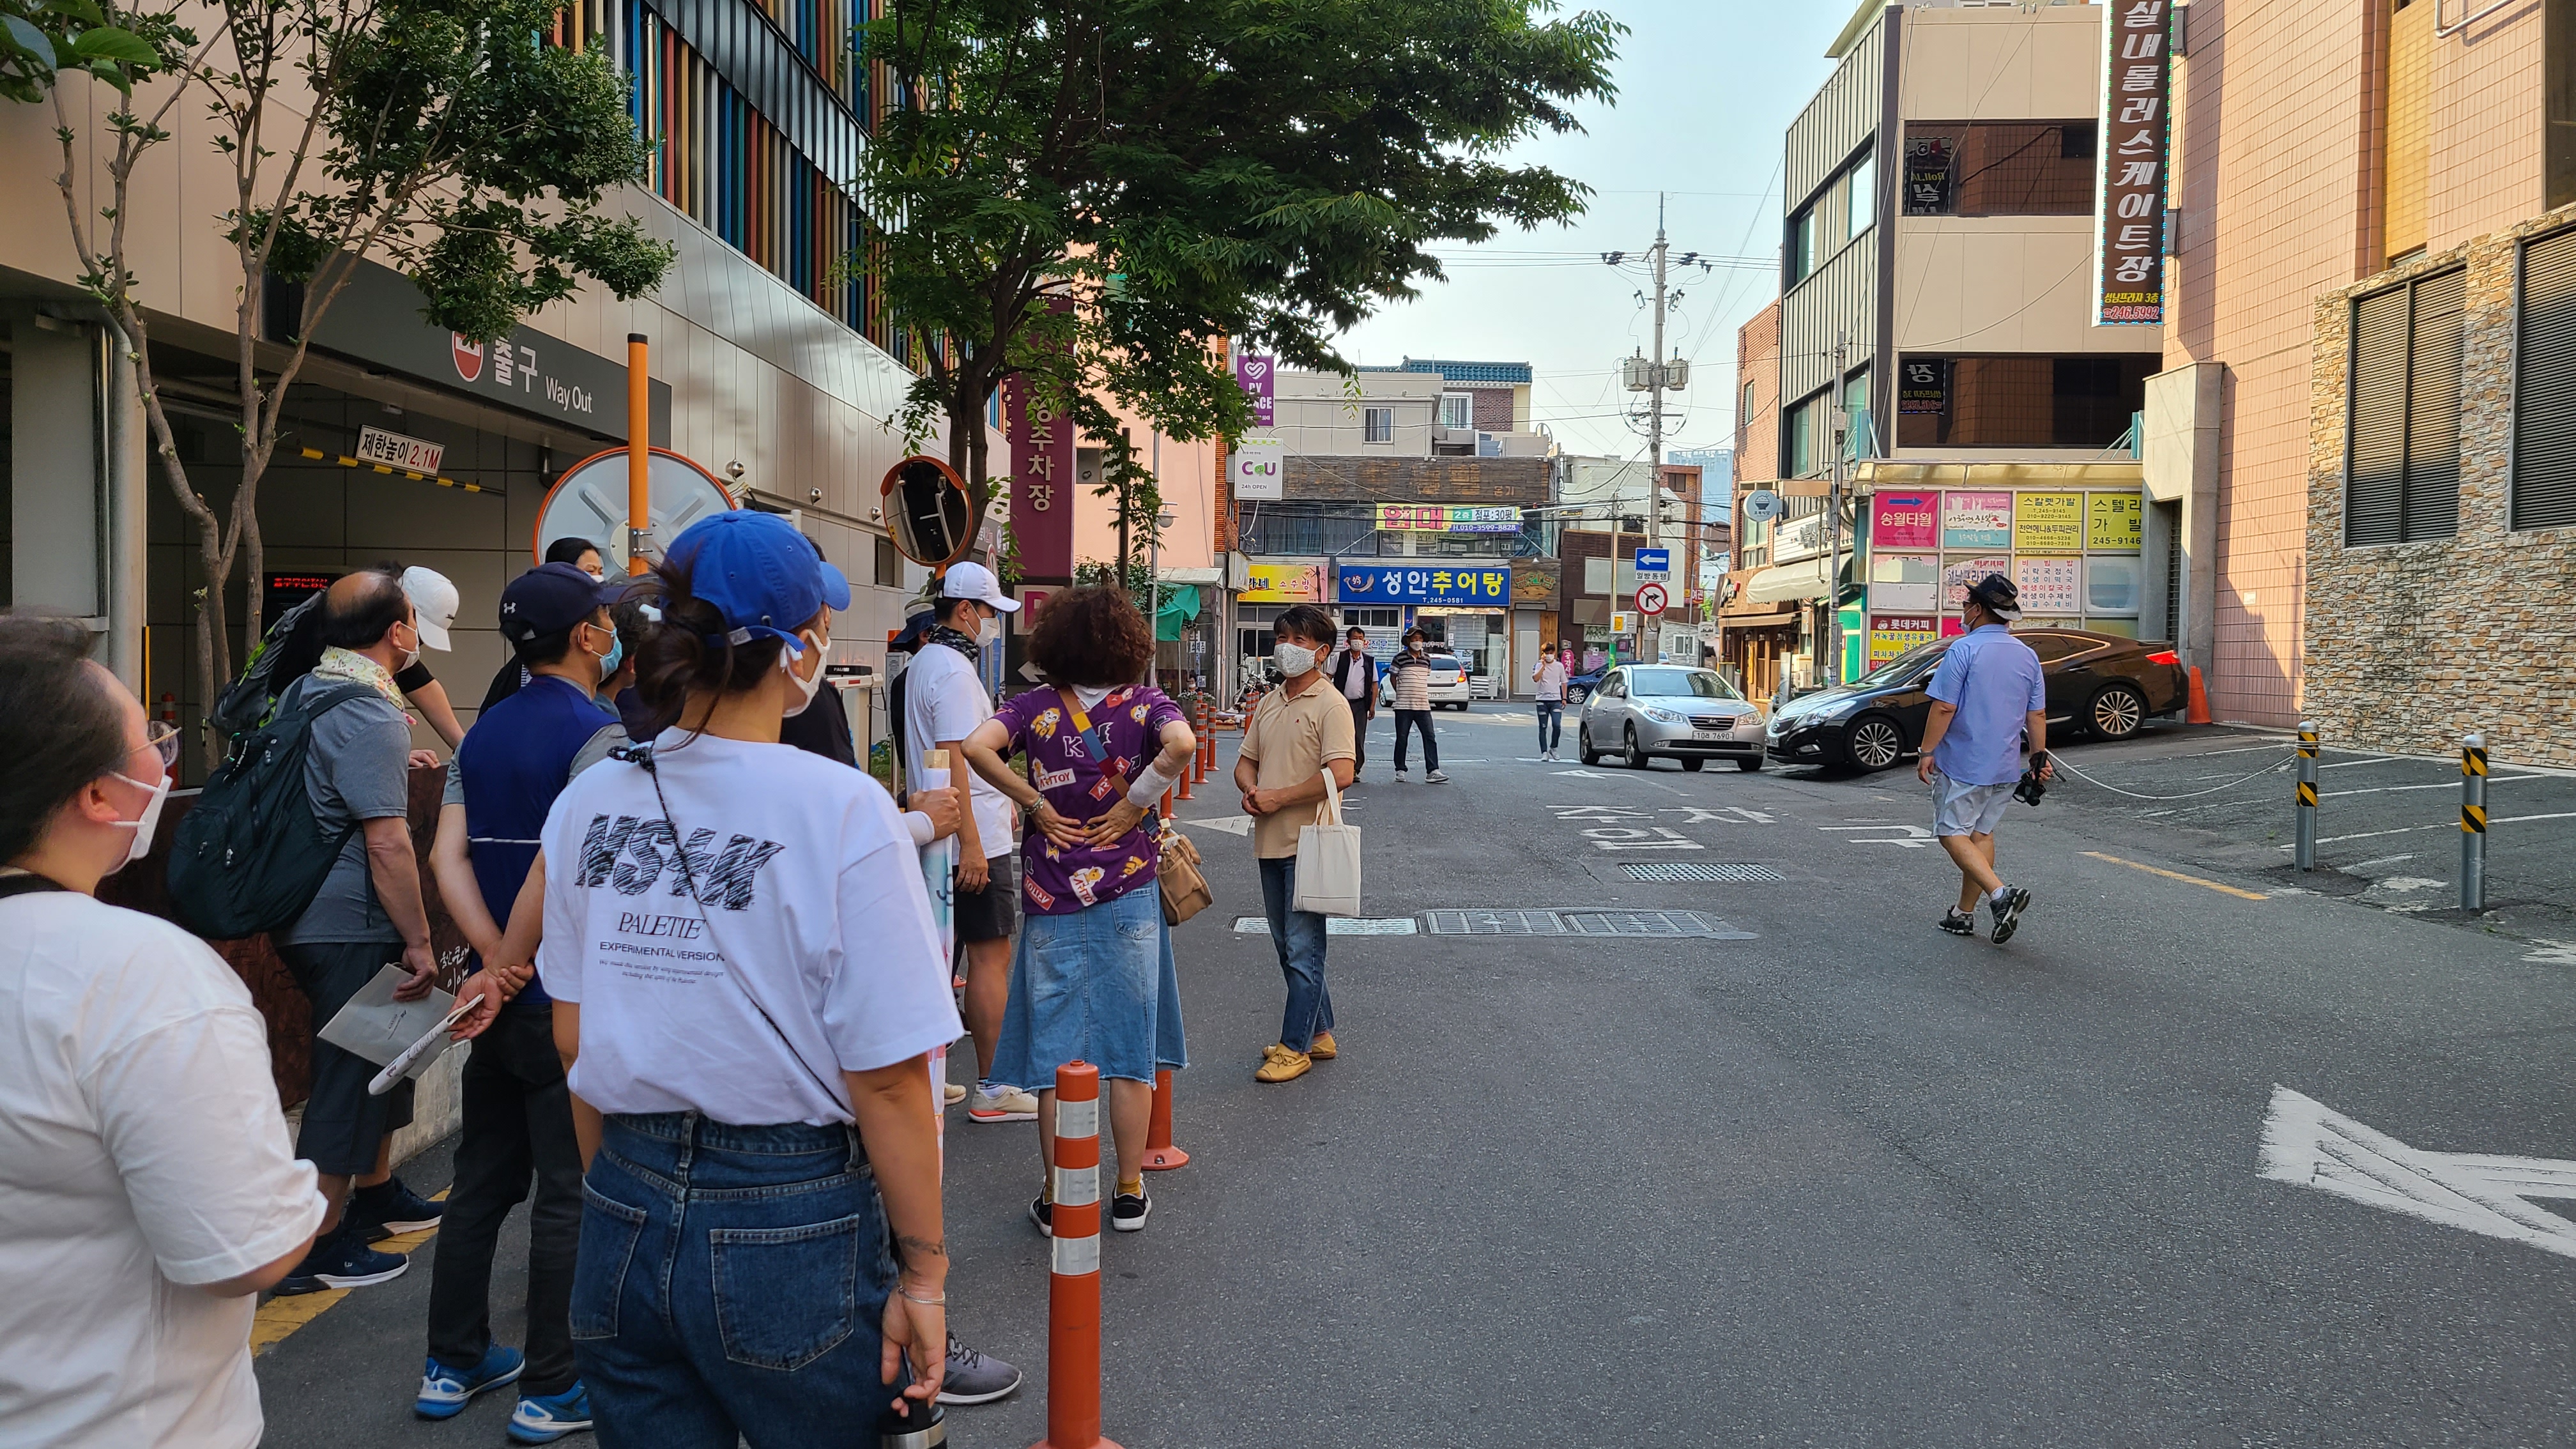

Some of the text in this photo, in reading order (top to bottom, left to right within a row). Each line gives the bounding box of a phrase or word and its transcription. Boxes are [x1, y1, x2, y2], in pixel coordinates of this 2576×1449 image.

[2114, 1, 2163, 282] 실내롤러스케이트장
[2104, 292, 2159, 303] 성남프라자 3층
[2111, 305, 2160, 319] 246.5992
[493, 336, 538, 392] 출구
[546, 376, 592, 413] Way Out
[362, 433, 440, 469] 제한높이 2.1M
[1383, 505, 1444, 530] 임대
[1880, 512, 1931, 526] 송월타월
[1278, 579, 1310, 590] 소주방
[1383, 571, 1504, 596] 성안추어탕
[1636, 572, 1667, 580] 일방통행
[1692, 589, 1703, 600] 여관
[1890, 619, 1929, 630] 롯데커피
[1062, 735, 1084, 757] K
[618, 912, 707, 940] PALETTE
[599, 942, 725, 962] EXPERIMENTAL VERSION
